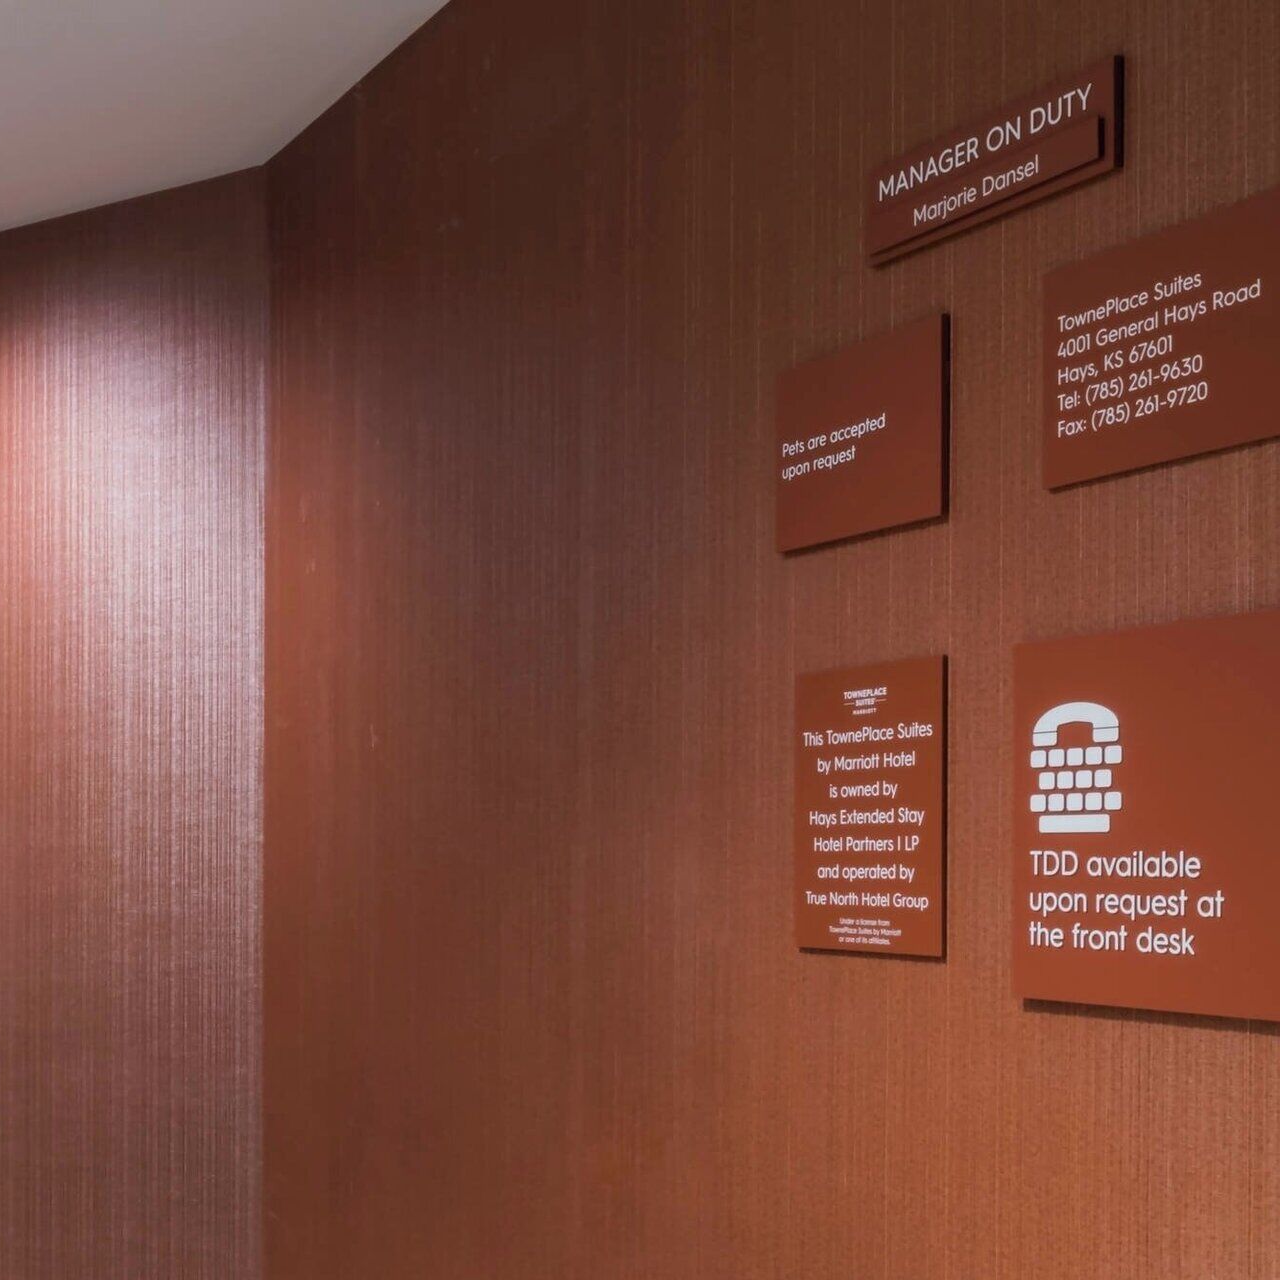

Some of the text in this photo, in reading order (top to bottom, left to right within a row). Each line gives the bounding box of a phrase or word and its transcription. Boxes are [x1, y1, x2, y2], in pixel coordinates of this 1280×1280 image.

[878, 83, 1093, 202] MANAGER ON DUTY
[913, 154, 1040, 226] Marjorie Dansel
[1057, 273, 1202, 333] TownePlace Suites
[1057, 278, 1262, 358] 4001 General Hays Road
[1057, 334, 1173, 386] Hays, KS 67601
[1057, 354, 1203, 412] Tel: (785) 261-9630
[1057, 381, 1208, 438] Fax: (785) 261-9720
[782, 412, 886, 458] Pets are accepted
[781, 444, 856, 481] upon request
[843, 686, 888, 700] TOWNEPLACE
[803, 722, 933, 748] This TownePlace Suites
[817, 750, 916, 776] by Marriott Hotel
[829, 780, 898, 799] is owned by
[809, 807, 925, 829] Hays Extended Stay
[813, 836, 842, 852] Hotel
[845, 836, 894, 852] Partners
[905, 835, 920, 851] LP
[817, 863, 915, 883] and operated by
[1029, 850, 1201, 878] TDD available
[805, 891, 929, 912] True North Hotel Group
[1029, 888, 1225, 922] upon request at
[1029, 921, 1195, 956] the front desk
